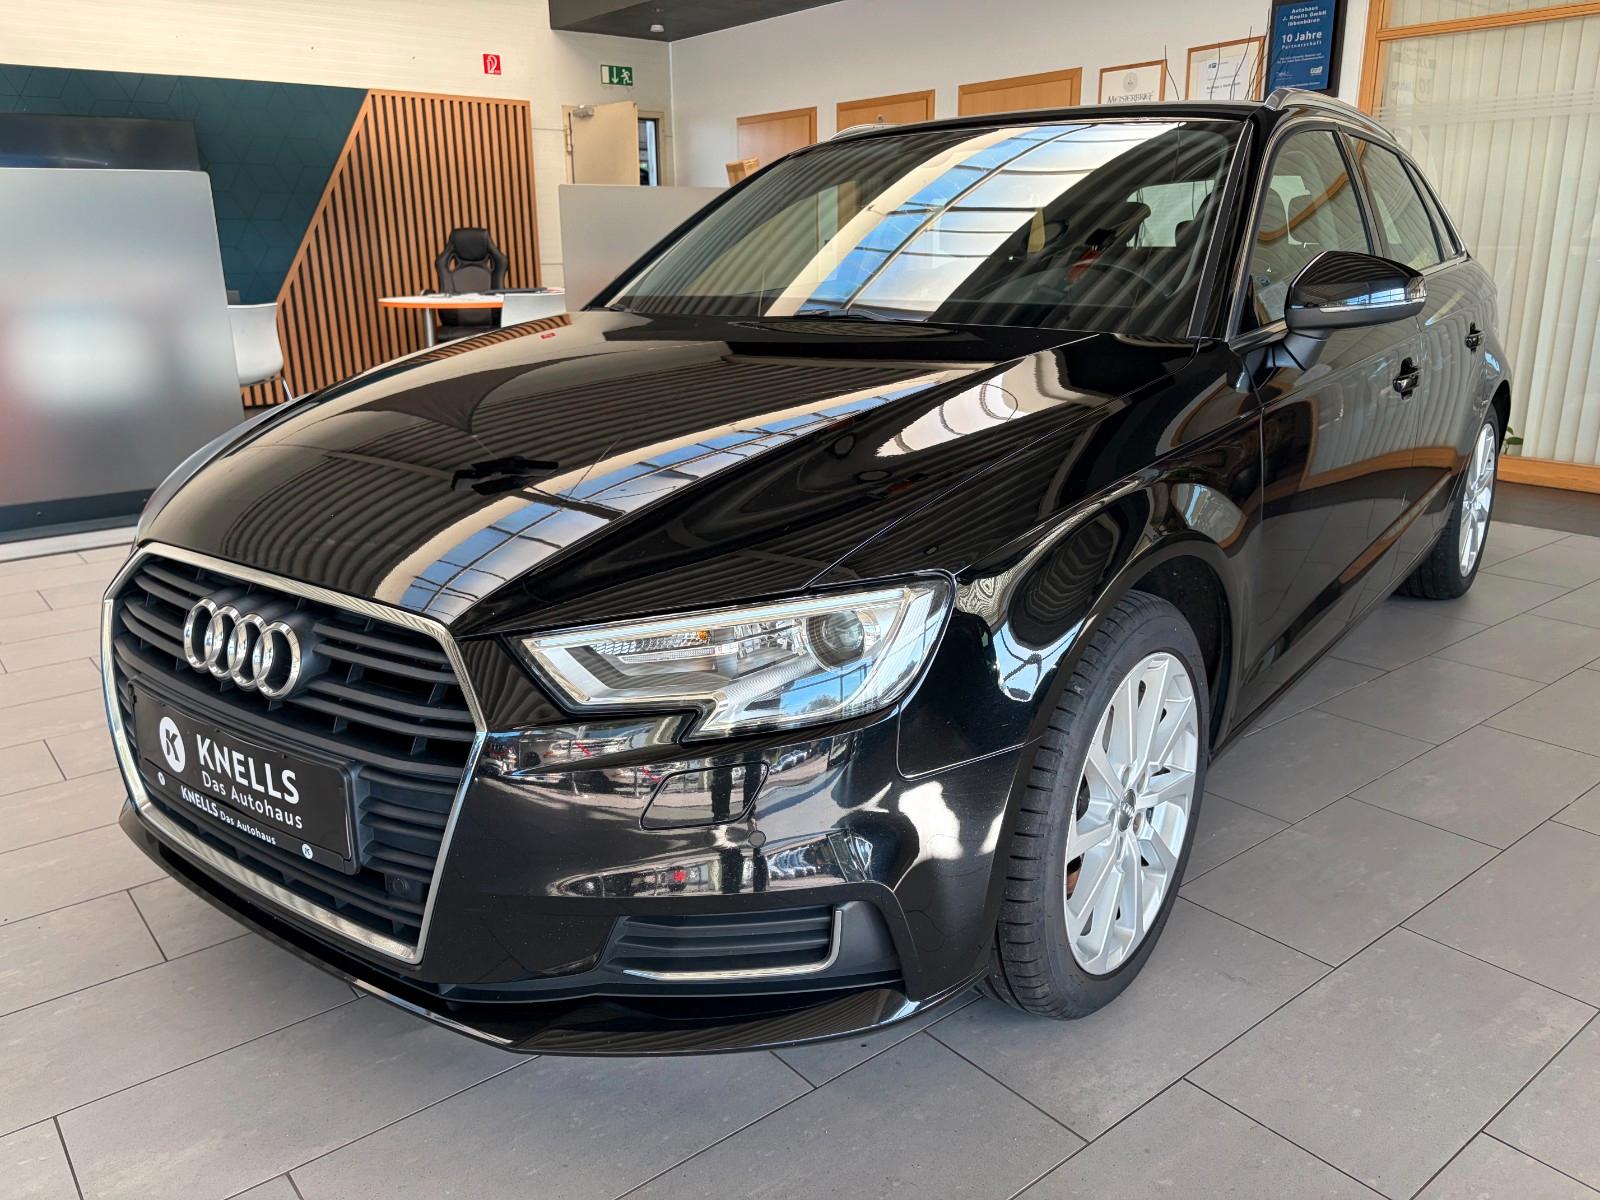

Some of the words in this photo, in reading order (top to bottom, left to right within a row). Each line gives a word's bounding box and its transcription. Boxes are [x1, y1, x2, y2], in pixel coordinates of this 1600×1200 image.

[1281, 33, 1293, 44] 10
[1294, 31, 1323, 42] Jahre
[196, 733, 300, 805] KNELLS
[180, 784, 219, 818] KNELLS
[220, 810, 235, 826] Das
[236, 820, 277, 846] Autohaus
[202, 770, 227, 797] Das
[231, 786, 303, 830] Autohaus
